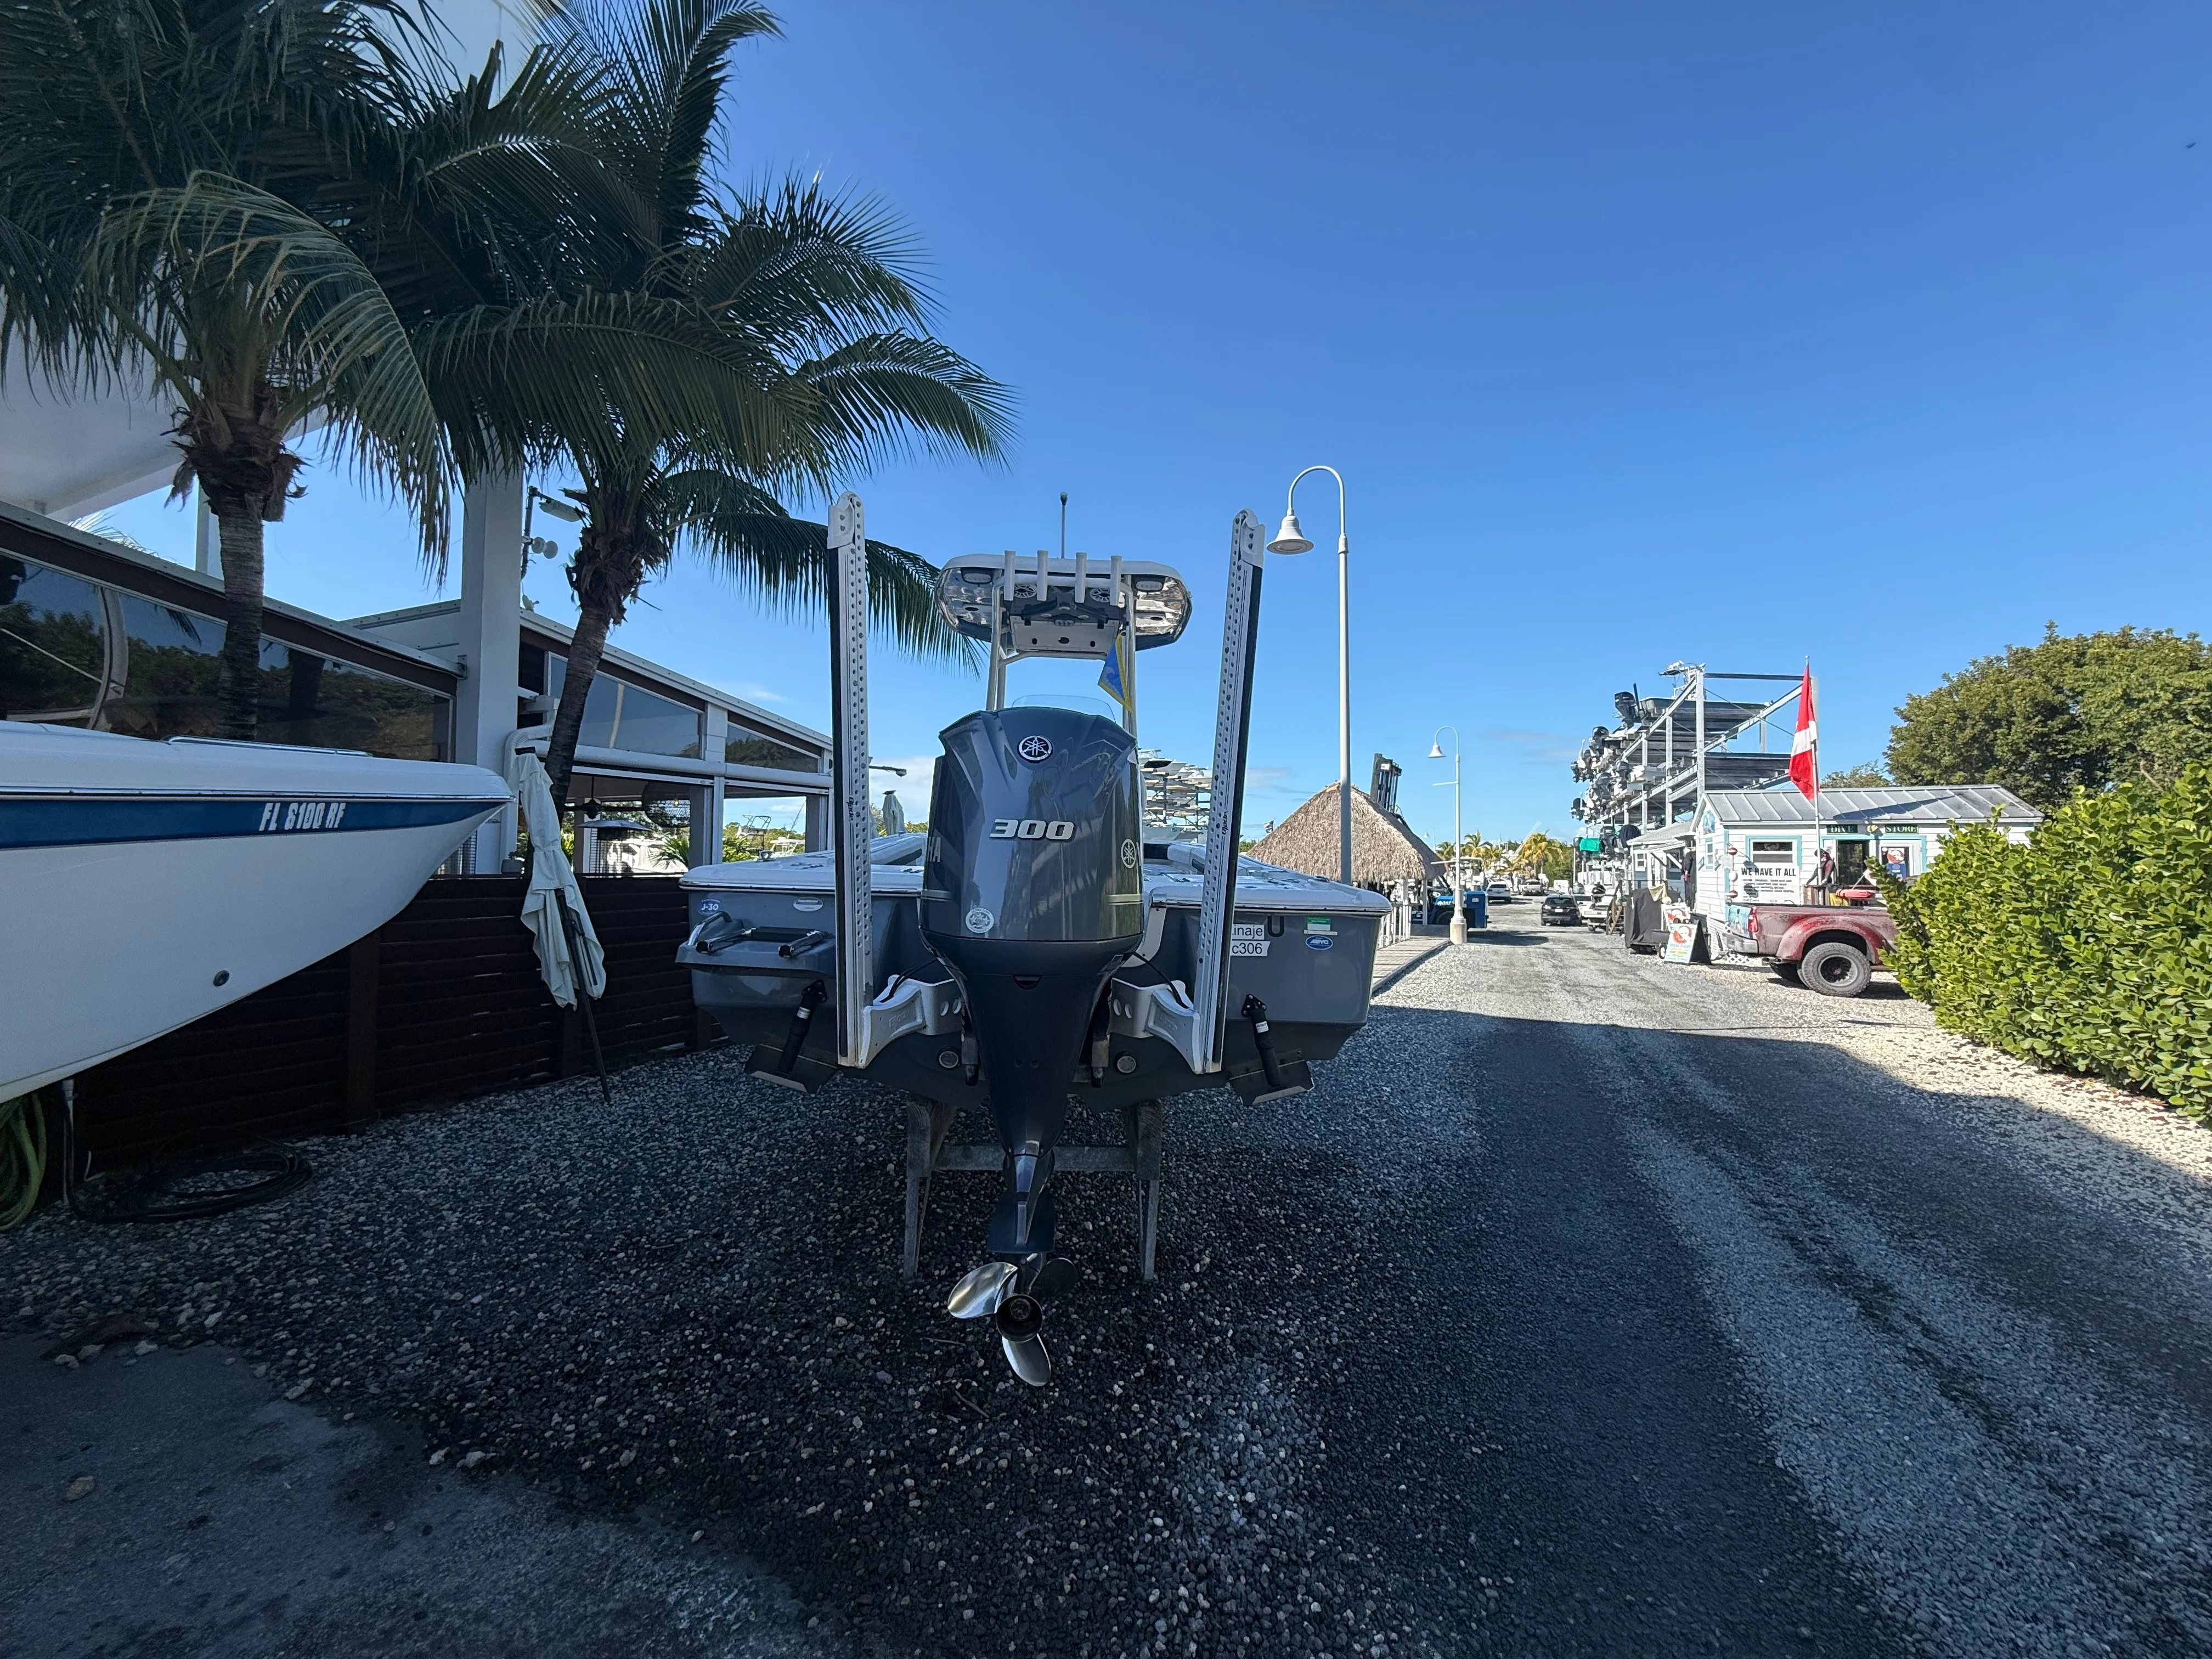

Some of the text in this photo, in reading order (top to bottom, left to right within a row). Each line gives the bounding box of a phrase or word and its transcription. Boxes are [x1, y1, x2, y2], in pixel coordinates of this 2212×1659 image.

[258, 803, 280, 831] FL
[990, 819, 1075, 840] 300
[1831, 824, 1917, 833] DIVE STORE
[927, 837, 941, 862] HA
[1741, 867, 1797, 877] WE HAVE IT ALL
[1232, 924, 1263, 939] inaje
